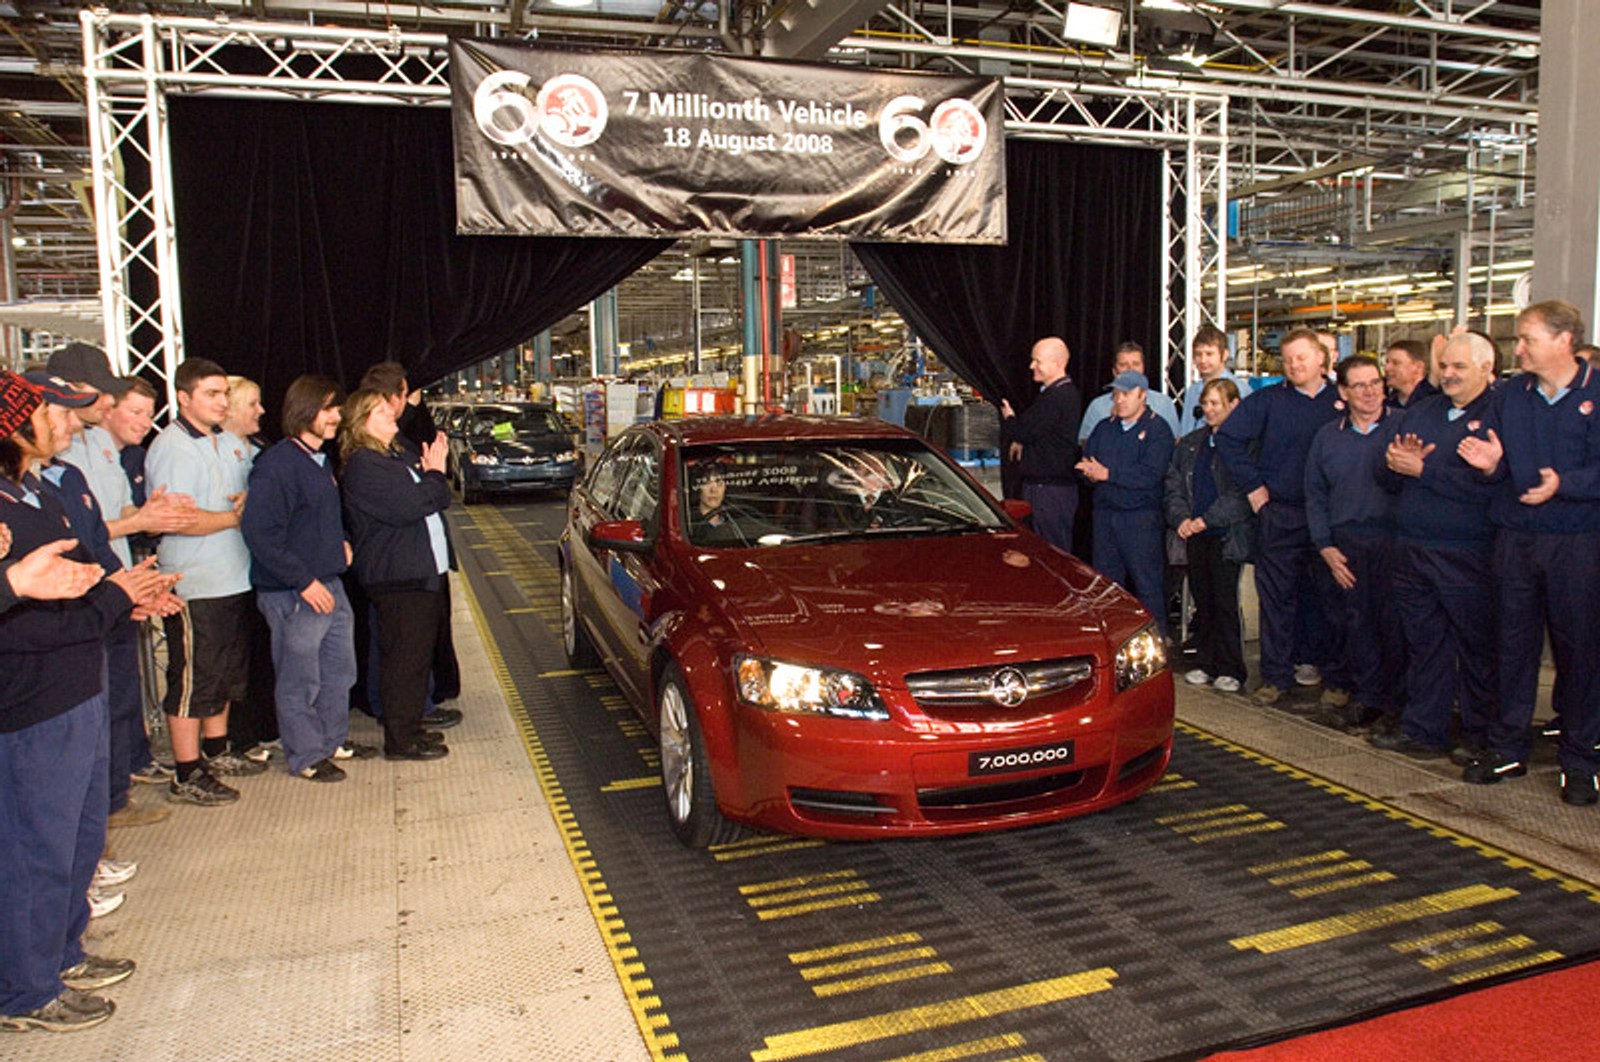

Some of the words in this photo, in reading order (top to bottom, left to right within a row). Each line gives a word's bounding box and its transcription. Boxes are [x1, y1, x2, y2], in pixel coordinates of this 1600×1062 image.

[622, 90, 640, 116] 7
[649, 92, 770, 121] Millionth
[777, 99, 868, 127] Vehicle
[662, 127, 691, 148] 18
[697, 128, 776, 155] August
[782, 133, 834, 153] 2008
